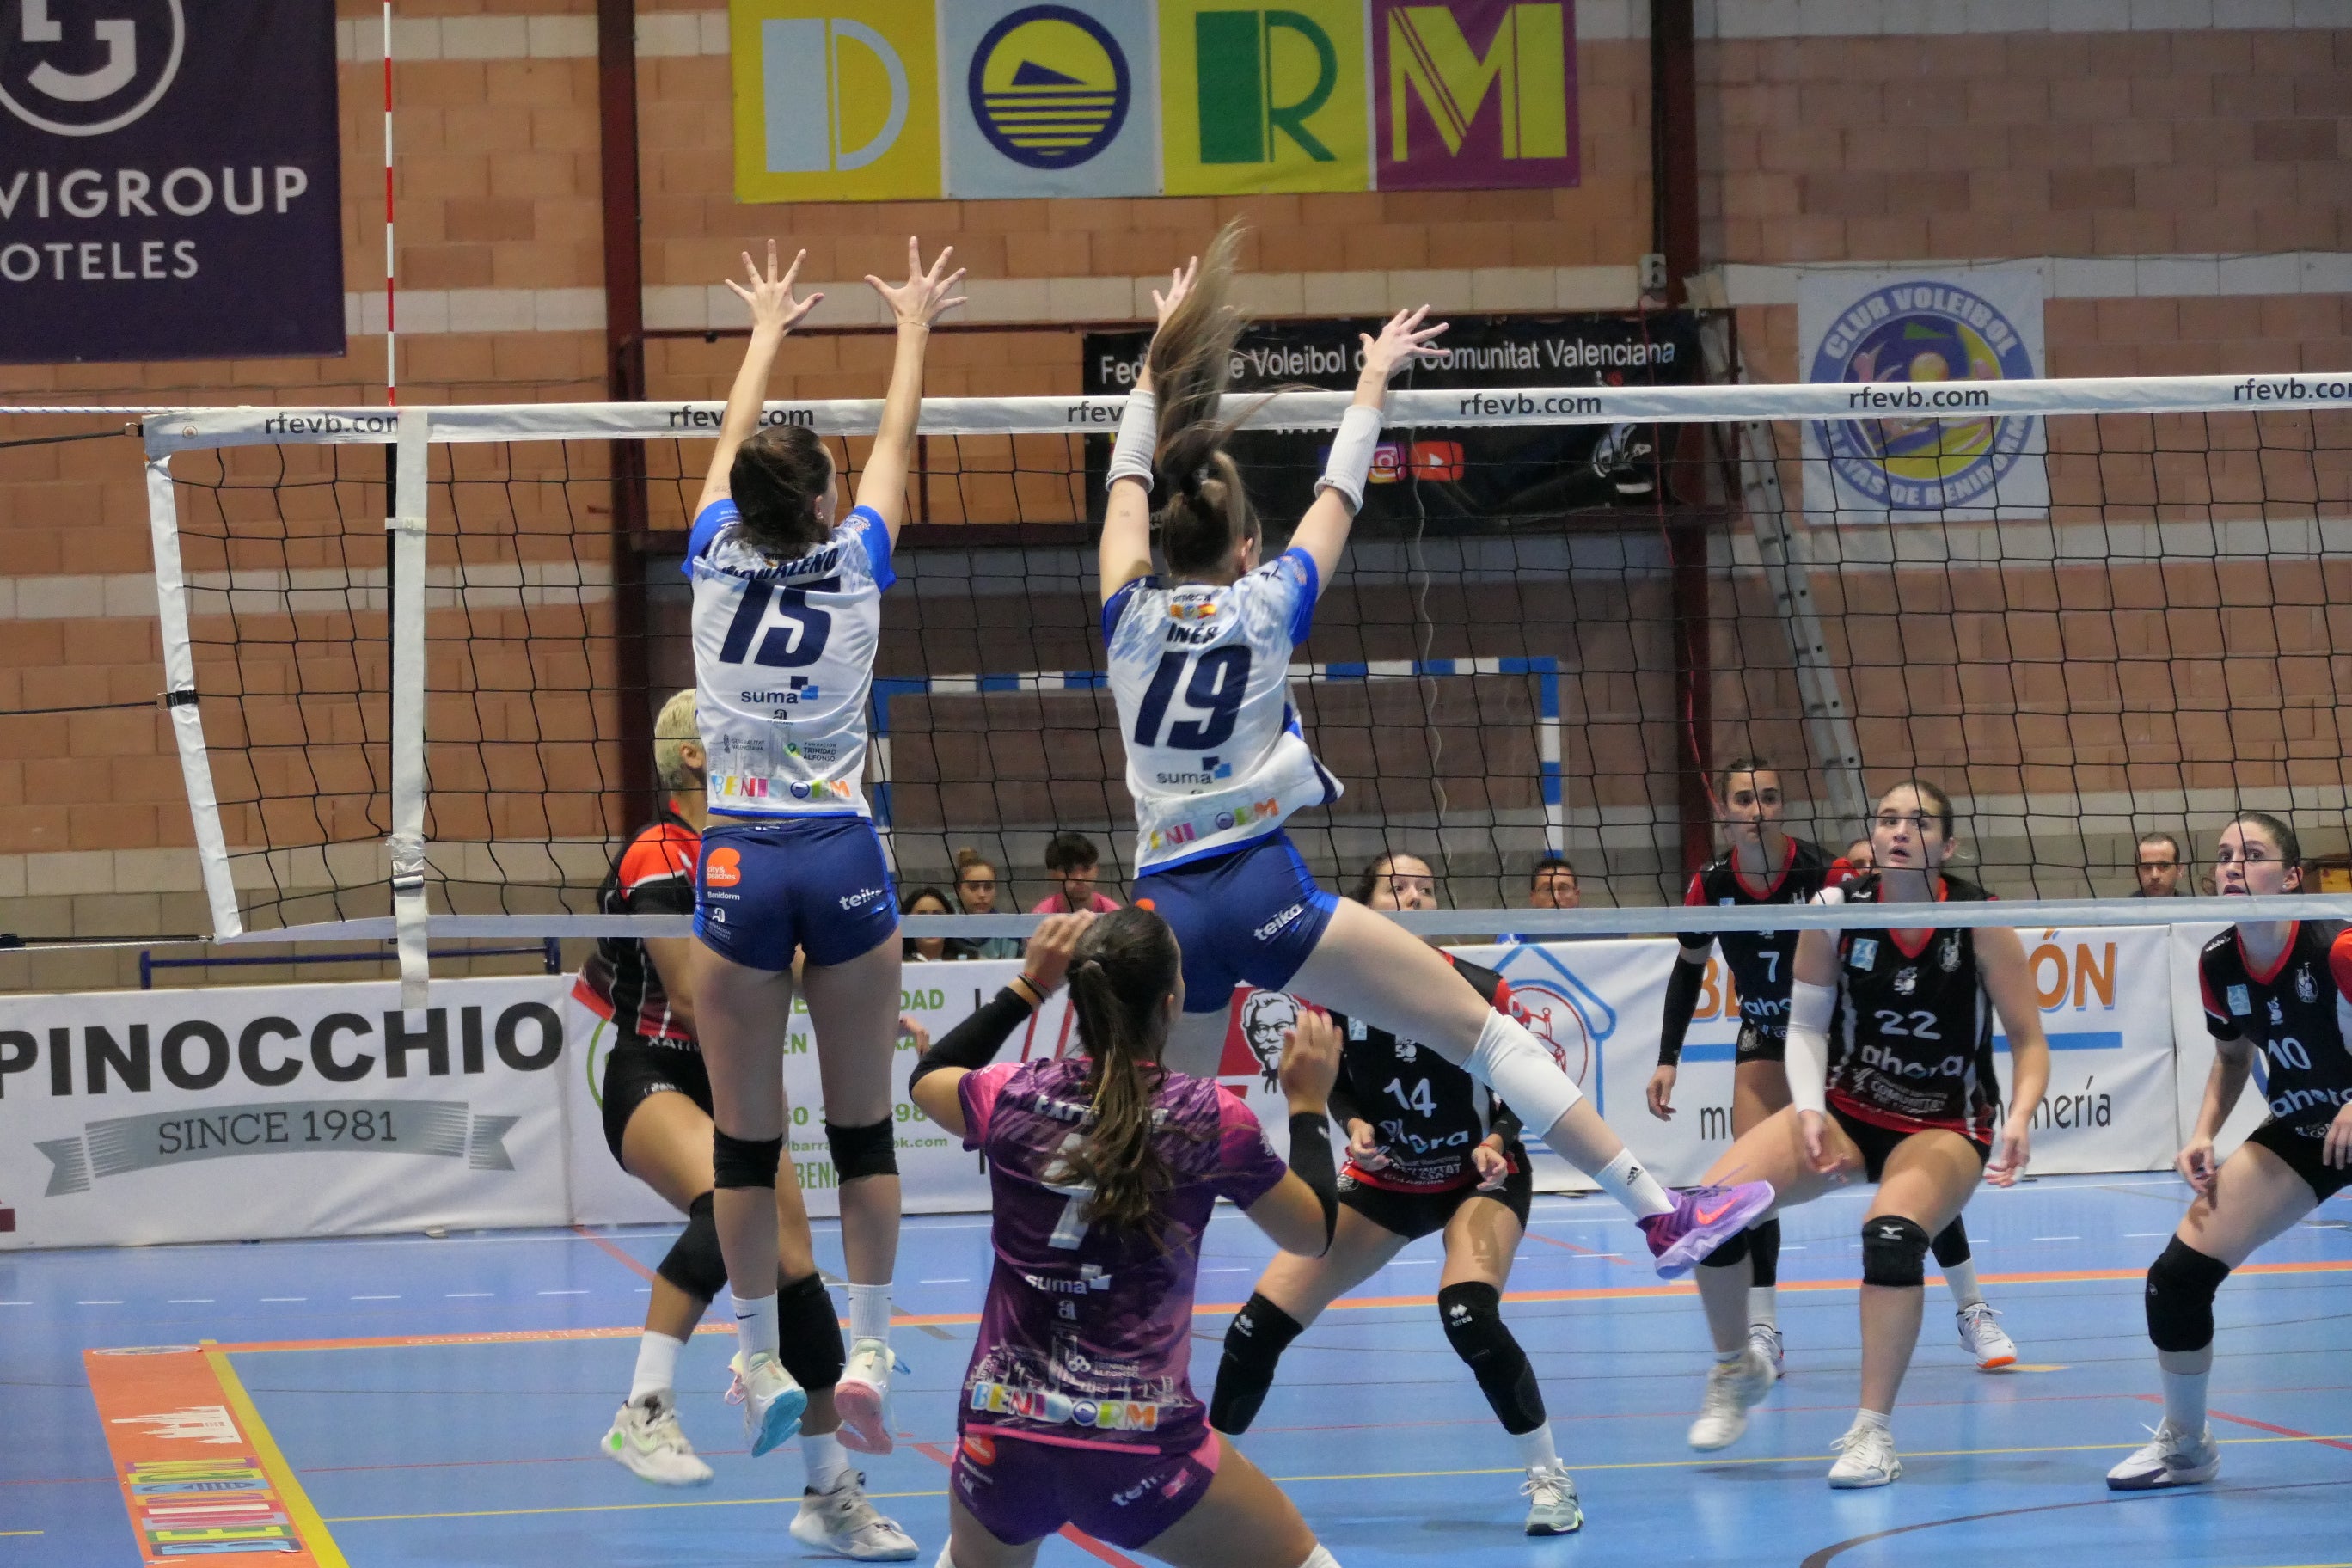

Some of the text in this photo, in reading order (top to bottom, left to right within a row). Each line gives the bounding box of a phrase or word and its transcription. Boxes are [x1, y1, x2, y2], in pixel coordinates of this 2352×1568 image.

[0, 240, 199, 282] OTELES
[1824, 286, 2018, 360] CLUB VOLEIBOL
[1251, 343, 1346, 377] Voleibol
[1421, 339, 1541, 371] Comunitat
[1546, 336, 1675, 368] Valenciana
[1461, 393, 1602, 416] rfevb.com
[1849, 386, 1990, 409] rfevb.com
[266, 412, 398, 434] rfevb.co
[670, 405, 814, 427] rfevcom
[718, 575, 841, 667] 15
[741, 690, 799, 704] suma
[1134, 645, 1252, 750] 19
[1156, 772, 1213, 785] suma
[707, 891, 740, 901] Benidorm
[1254, 903, 1304, 940] teika
[1758, 951, 1780, 983] 7
[1874, 1009, 1942, 1040] 22
[0, 1001, 564, 1099] PINOCCHIO
[1861, 1045, 1964, 1079] ahora
[2268, 1037, 2312, 1069] 10
[1382, 1077, 1437, 1118] 14
[159, 1109, 398, 1155] SINCE 1981
[1024, 1274, 1087, 1295] suma
